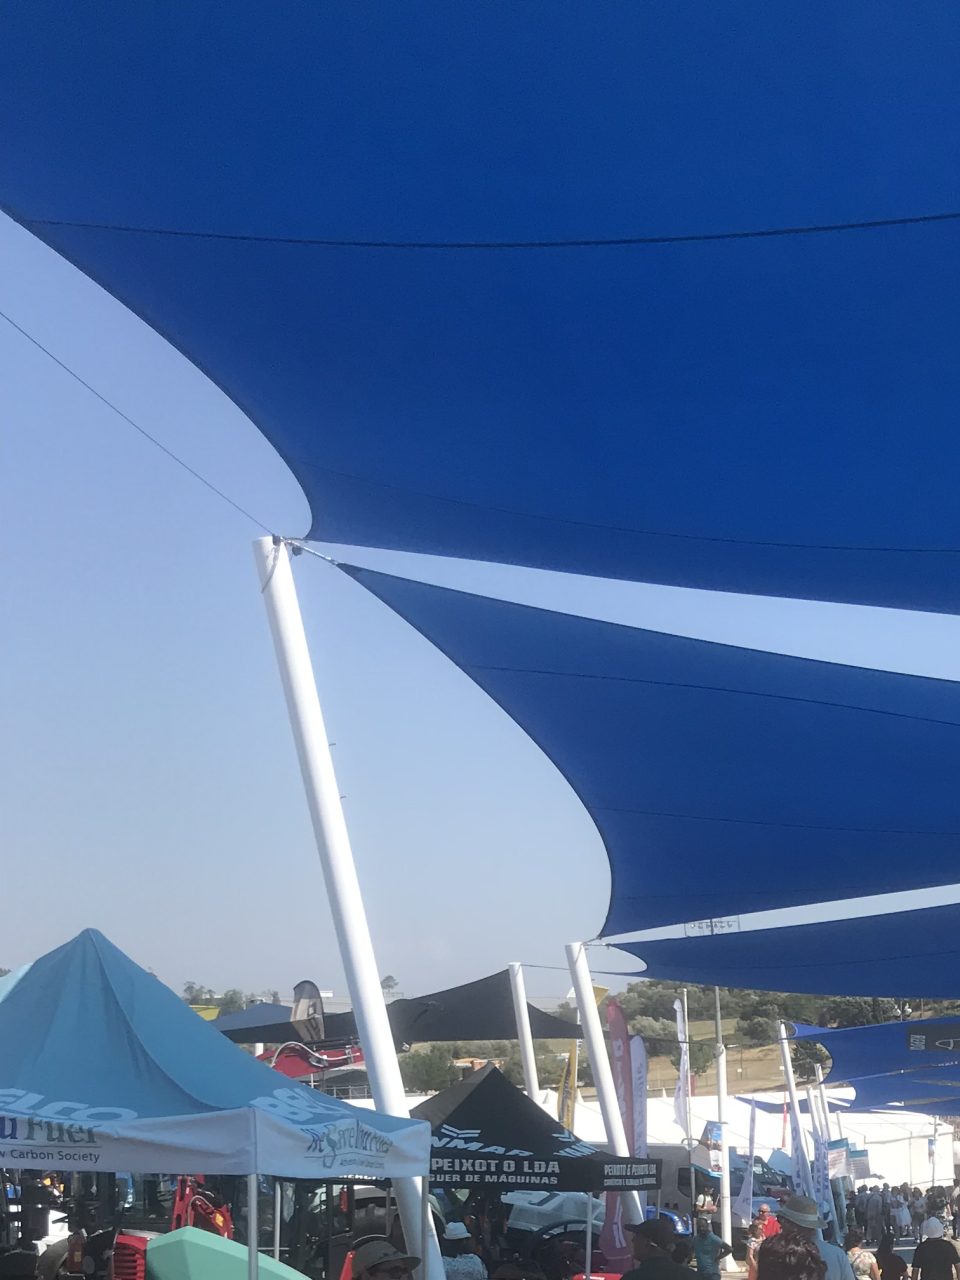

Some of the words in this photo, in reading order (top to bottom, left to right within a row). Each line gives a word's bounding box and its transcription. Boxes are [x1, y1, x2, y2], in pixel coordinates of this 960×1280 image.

[10, 1149, 54, 1160] Carbon
[58, 1150, 100, 1164] Society
[523, 1160, 561, 1174] LDA
[465, 1174, 480, 1182] DE
[485, 1173, 558, 1185] MÁQUINAS
